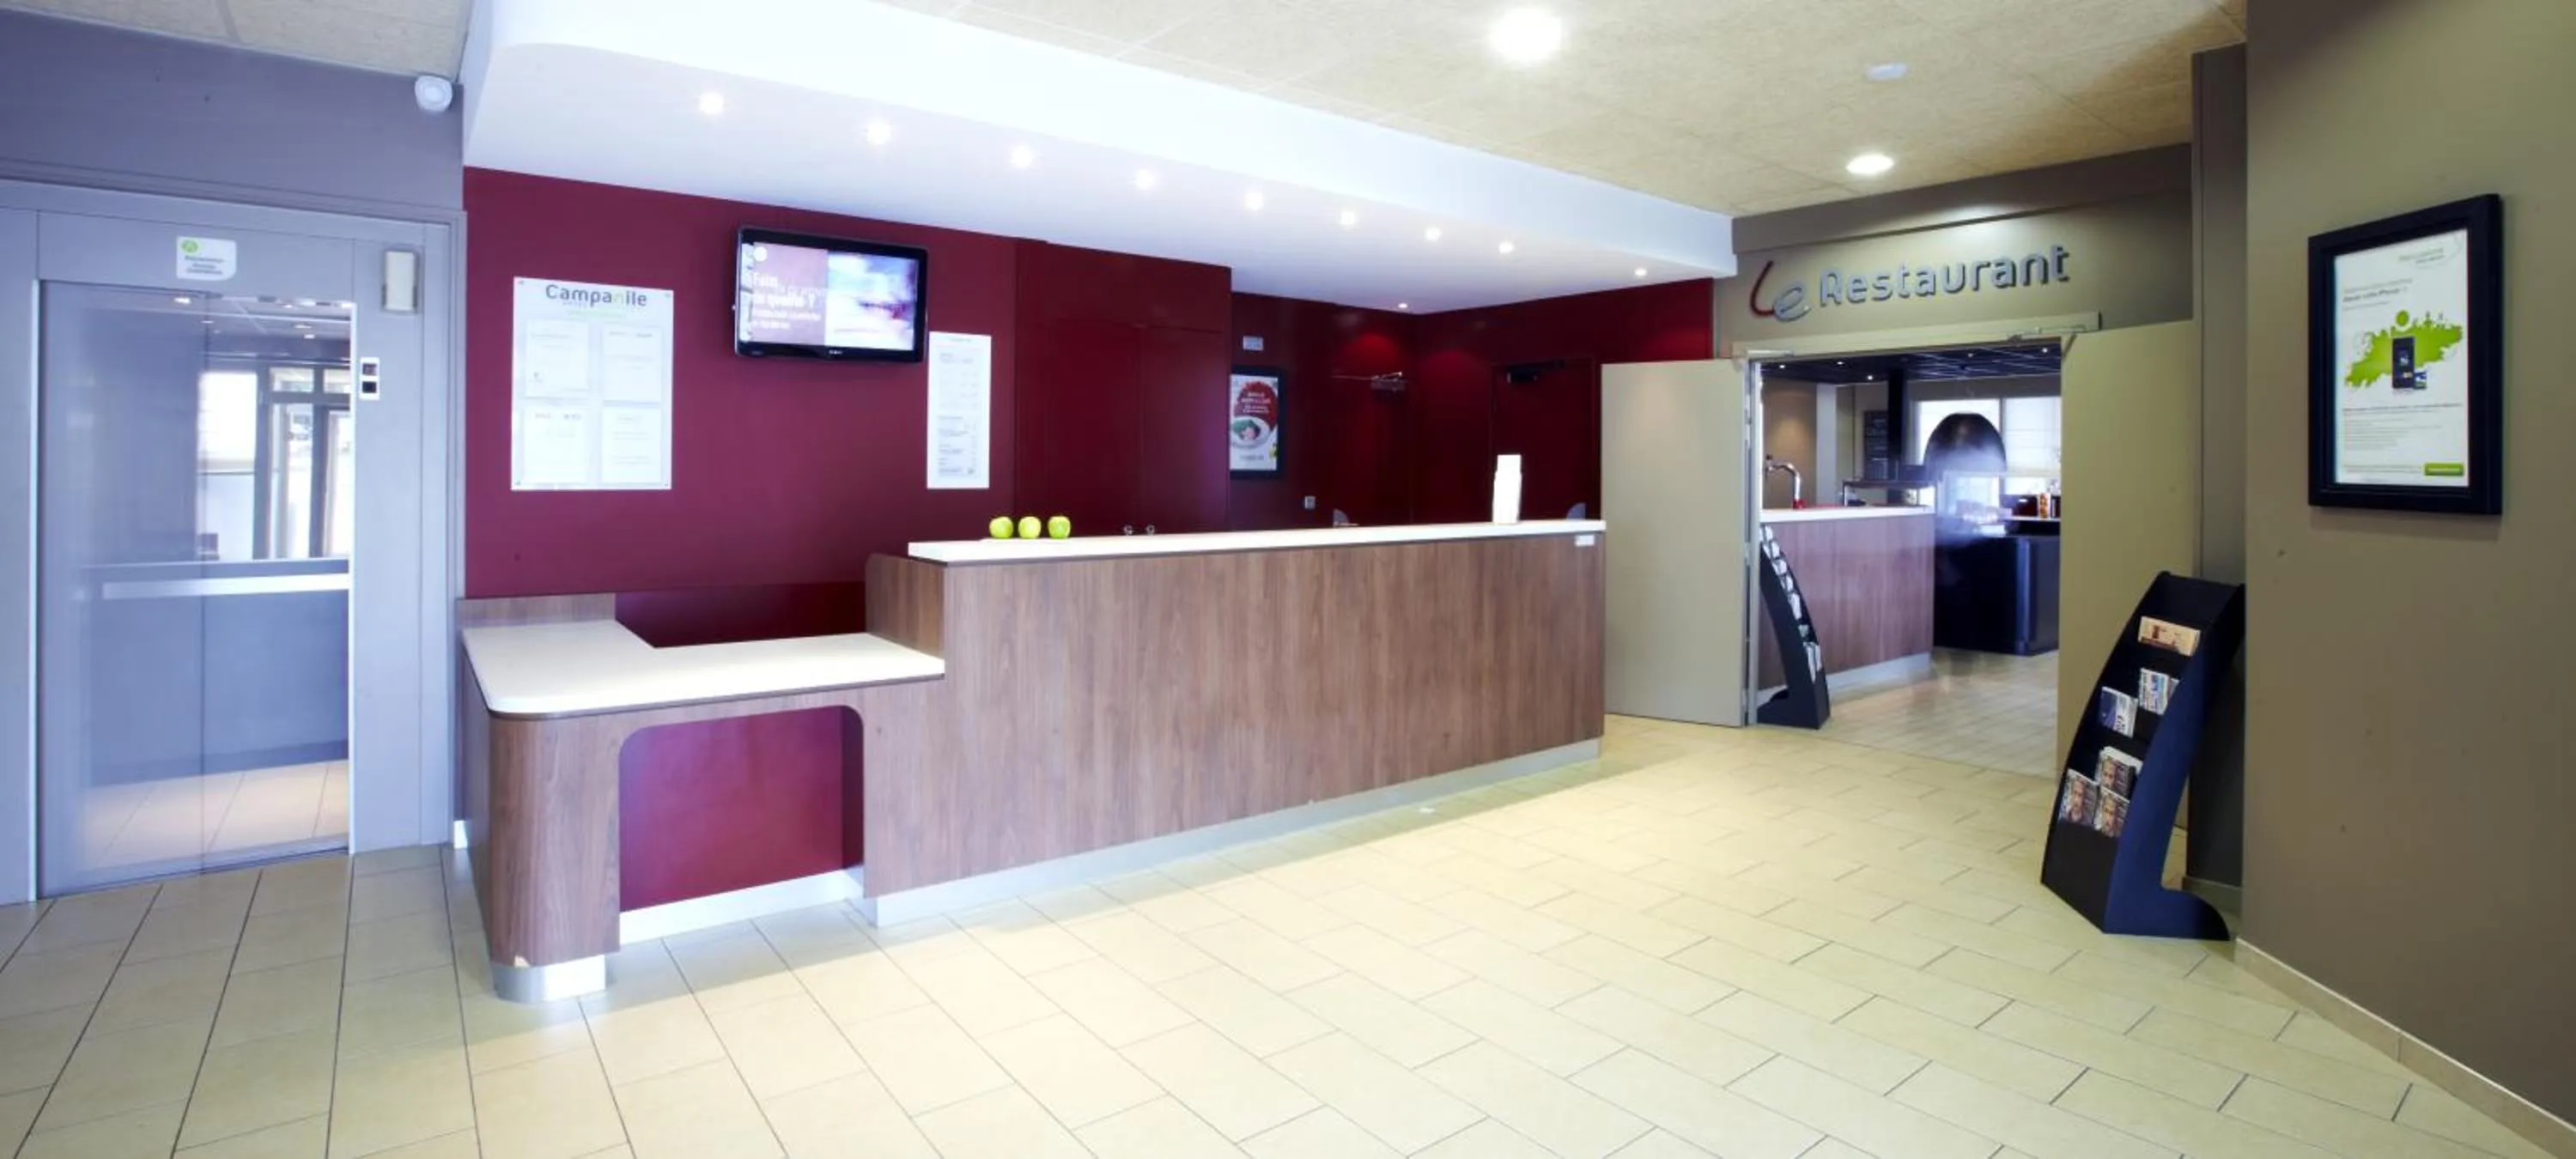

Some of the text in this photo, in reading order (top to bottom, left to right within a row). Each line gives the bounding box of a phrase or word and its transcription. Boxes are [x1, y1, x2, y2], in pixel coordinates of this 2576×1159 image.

[545, 283, 647, 307] Campanile
[1750, 245, 2071, 322] Le Restaurant
